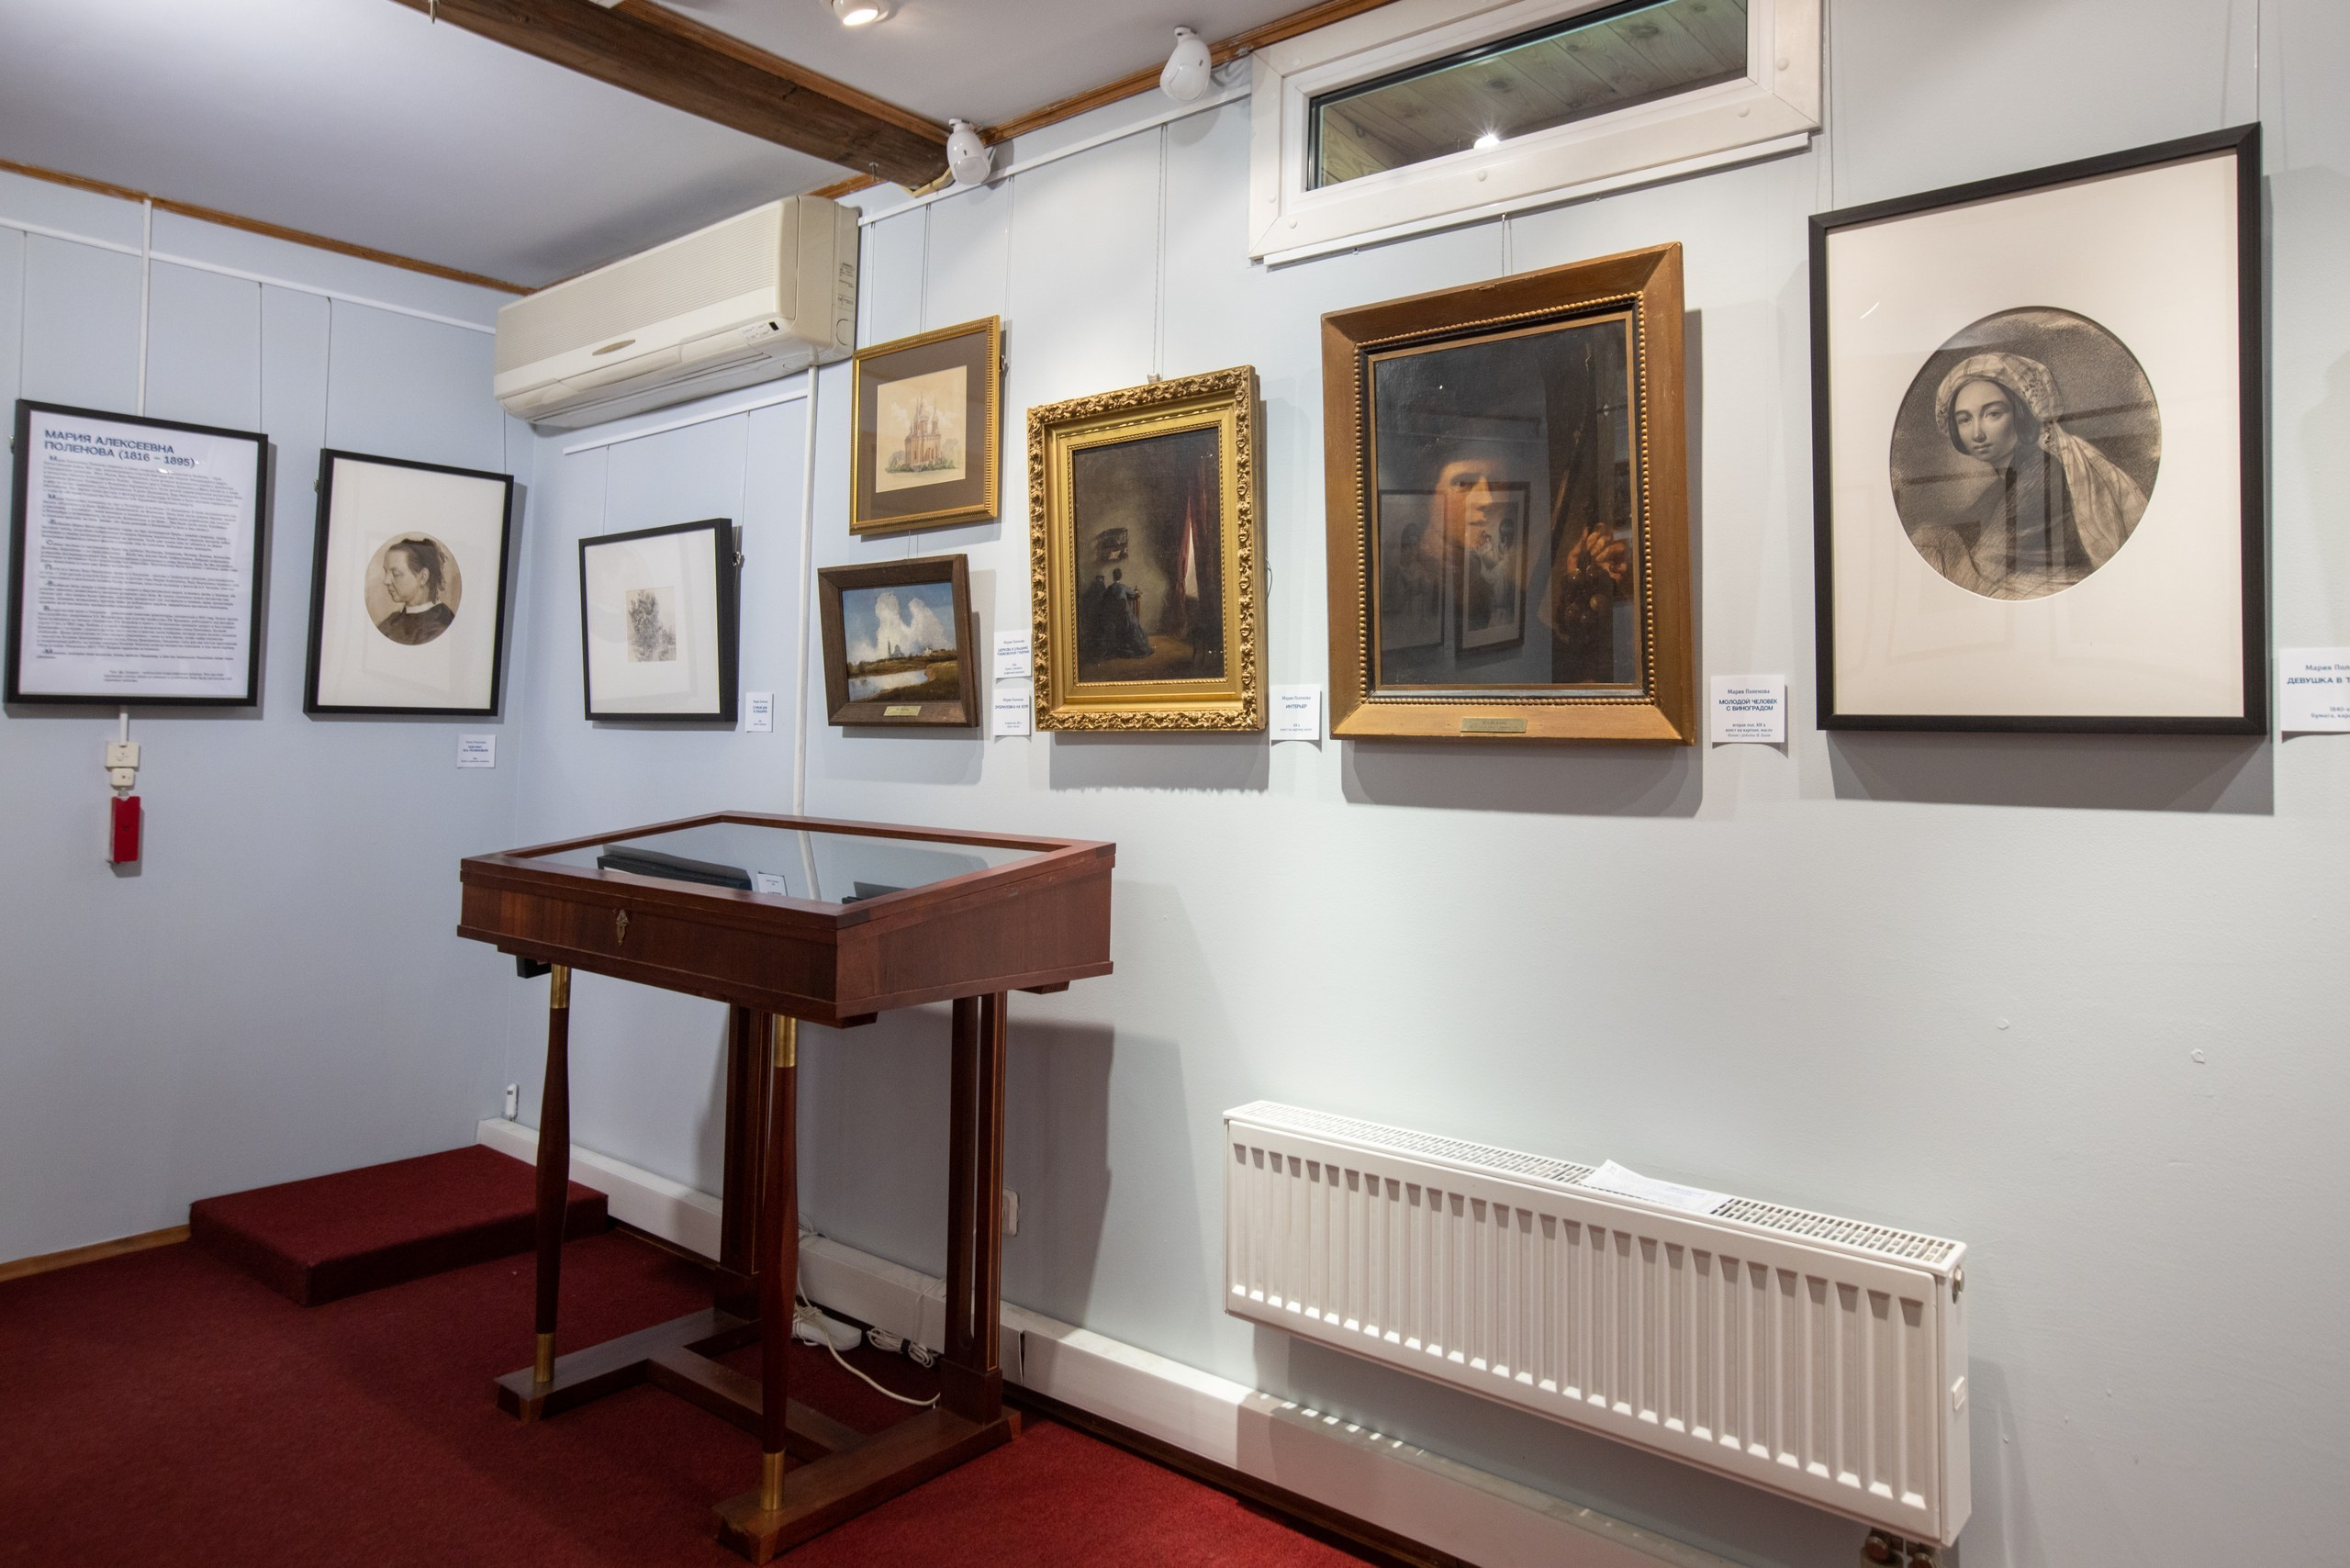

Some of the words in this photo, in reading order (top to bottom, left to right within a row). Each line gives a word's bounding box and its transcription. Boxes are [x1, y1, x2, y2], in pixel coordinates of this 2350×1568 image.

[44, 429, 92, 444] МАРИЯ
[95, 435, 174, 454] АЛЕКСЕЕВНА
[44, 441, 115, 457] ПОЛЕНОВА
[118, 450, 151, 463] (1816
[163, 455, 196, 468] 1895)
[2305, 664, 2333, 672] Мария
[2287, 677, 2333, 685] ДЕВУШКА
